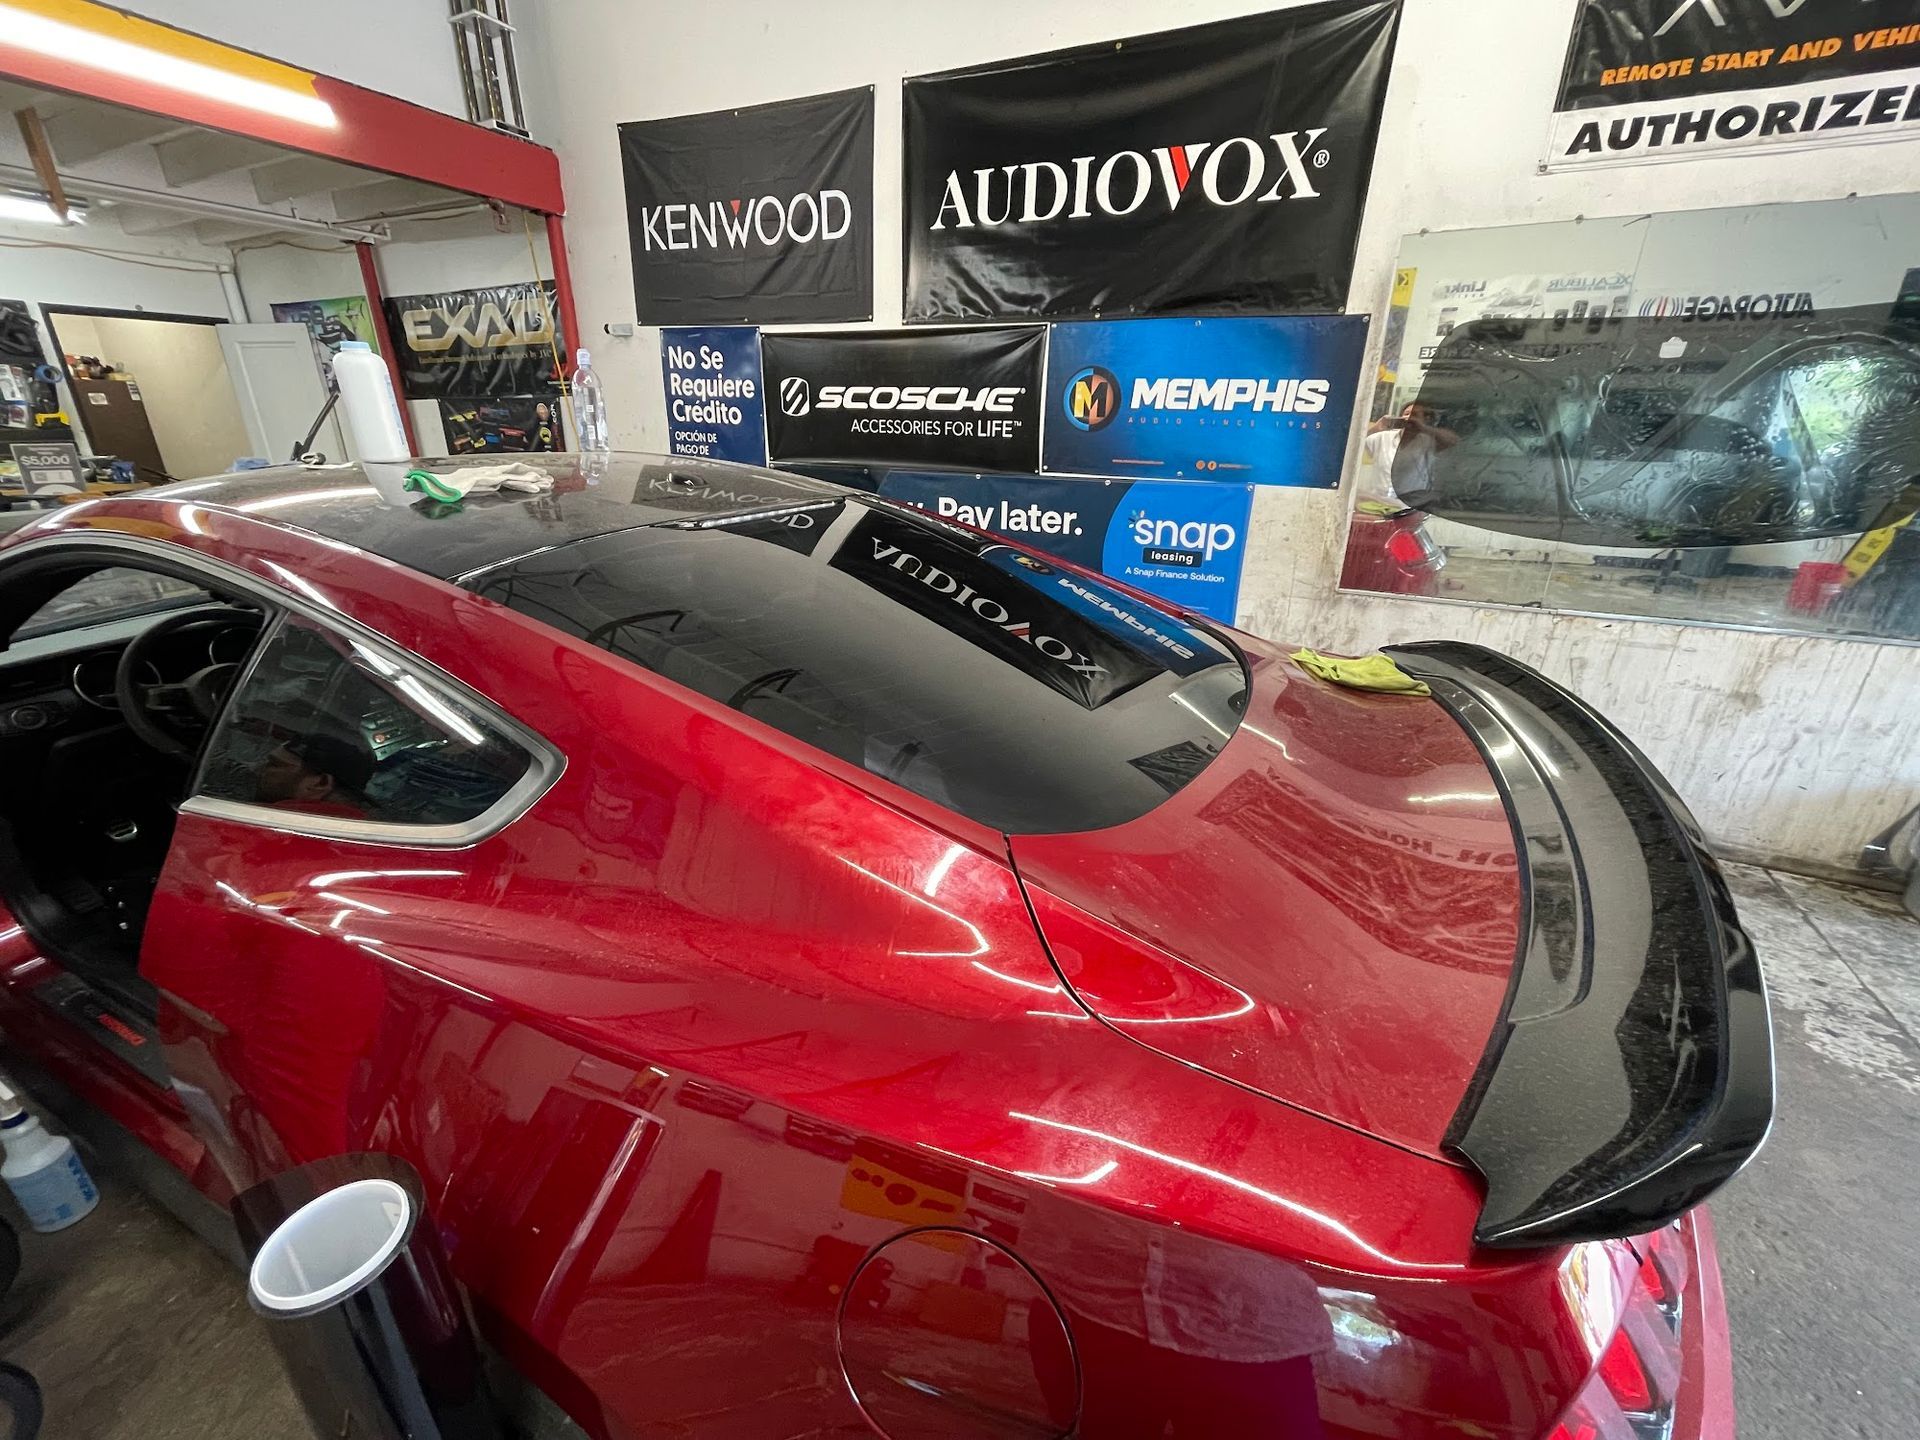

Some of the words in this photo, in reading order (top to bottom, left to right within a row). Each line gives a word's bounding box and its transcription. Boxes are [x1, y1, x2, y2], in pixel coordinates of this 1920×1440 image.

[1600, 58, 1695, 86] REMOTE
[1700, 48, 1774, 73] START
[1778, 37, 1842, 64] AND
[1853, 24, 1920, 52] VEHI
[641, 189, 852, 250] KENWOOD
[668, 345, 696, 369] No
[700, 345, 724, 370] Se
[670, 372, 755, 402] Requiere
[1130, 377, 1330, 413] MEMPHIS
[672, 399, 742, 425] Crédito
[1128, 417, 1182, 426] AUDIO
[1200, 418, 1255, 428] SINCE
[675, 430, 706, 442] OPCIÓN
[708, 432, 718, 443] DE
[851, 418, 941, 436] ACCESSORIES
[944, 420, 974, 437] FOR
[20, 455, 70, 466] $5,000
[676, 443, 698, 454] PAGO
[700, 445, 709, 455] DE
[938, 496, 995, 531] Pay
[1000, 500, 1084, 536] later.
[1134, 518, 1236, 561] snap
[1151, 550, 1194, 565] leasing
[1125, 566, 1132, 574] A
[1133, 567, 1154, 579] Snap
[1156, 569, 1189, 580] Finance
[1190, 572, 1225, 584] Solution
